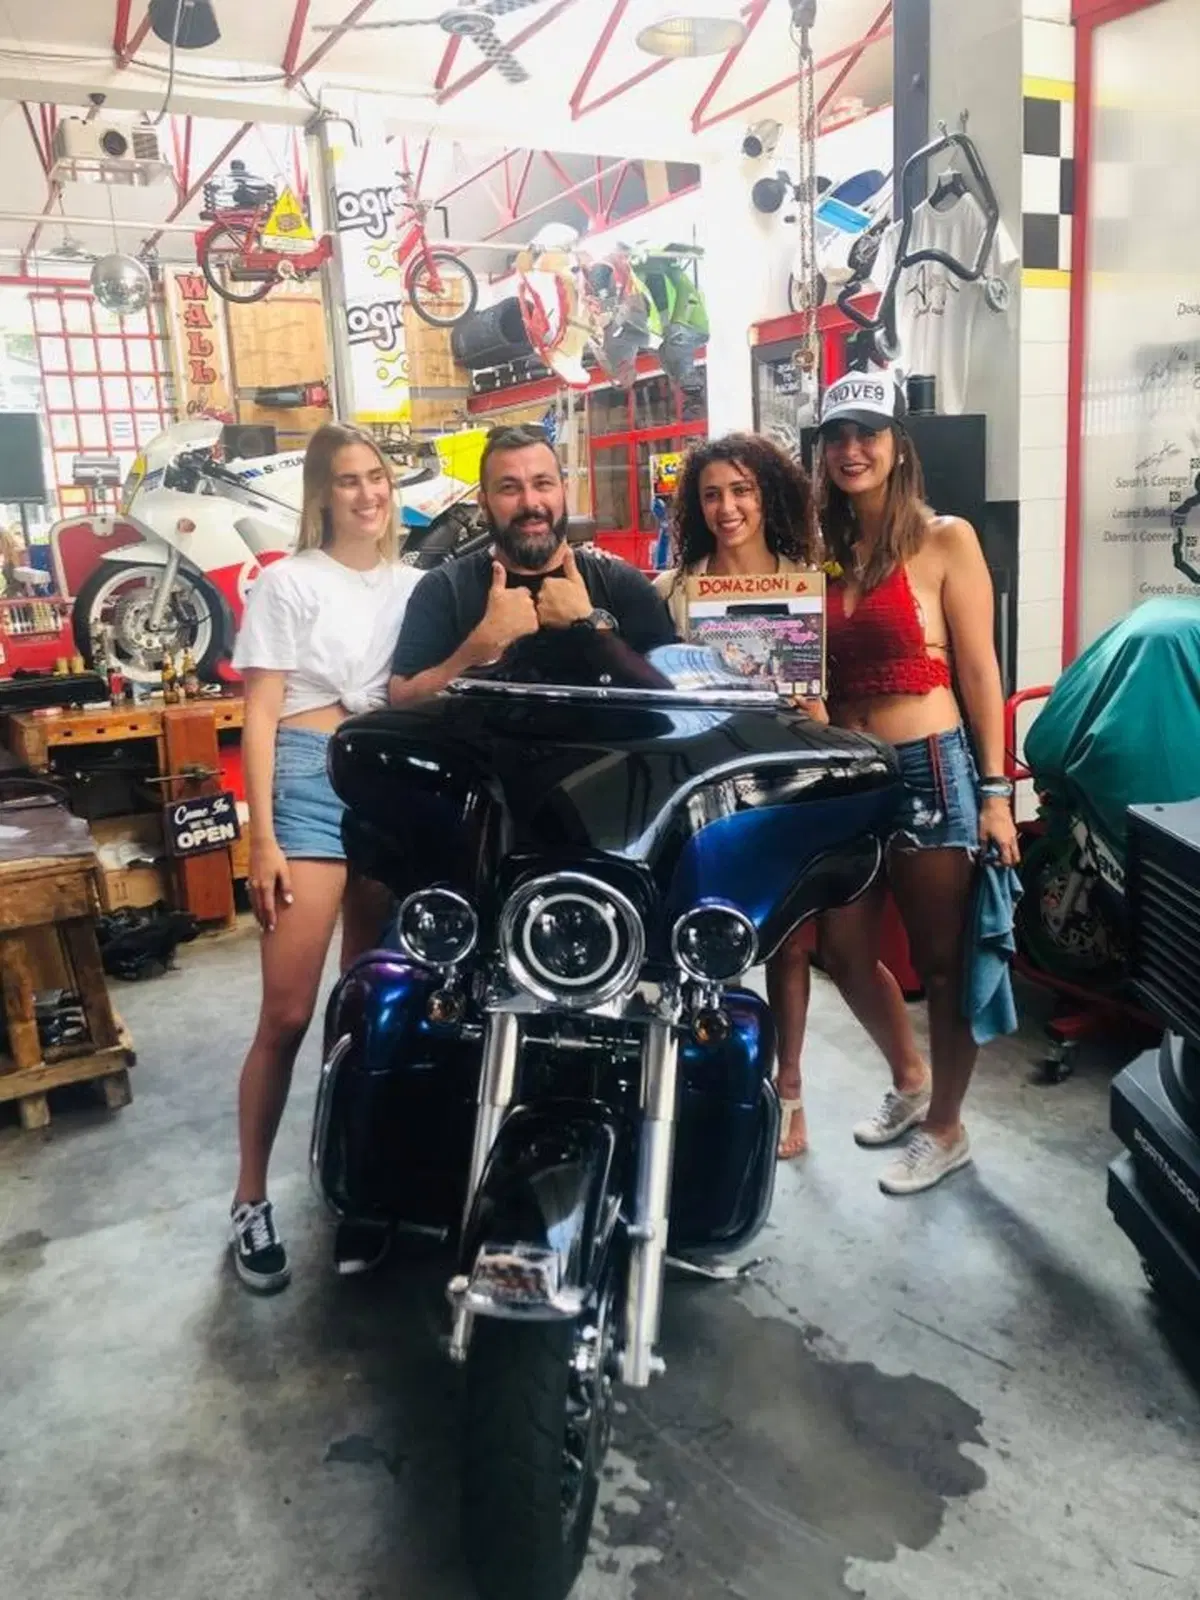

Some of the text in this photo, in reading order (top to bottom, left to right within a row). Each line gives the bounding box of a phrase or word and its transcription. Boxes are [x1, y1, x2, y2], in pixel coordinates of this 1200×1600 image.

[174, 274, 217, 384] WALL
[698, 578, 789, 597] DONAZIONI
[174, 805, 209, 826] Come
[177, 822, 236, 849] OPEN
